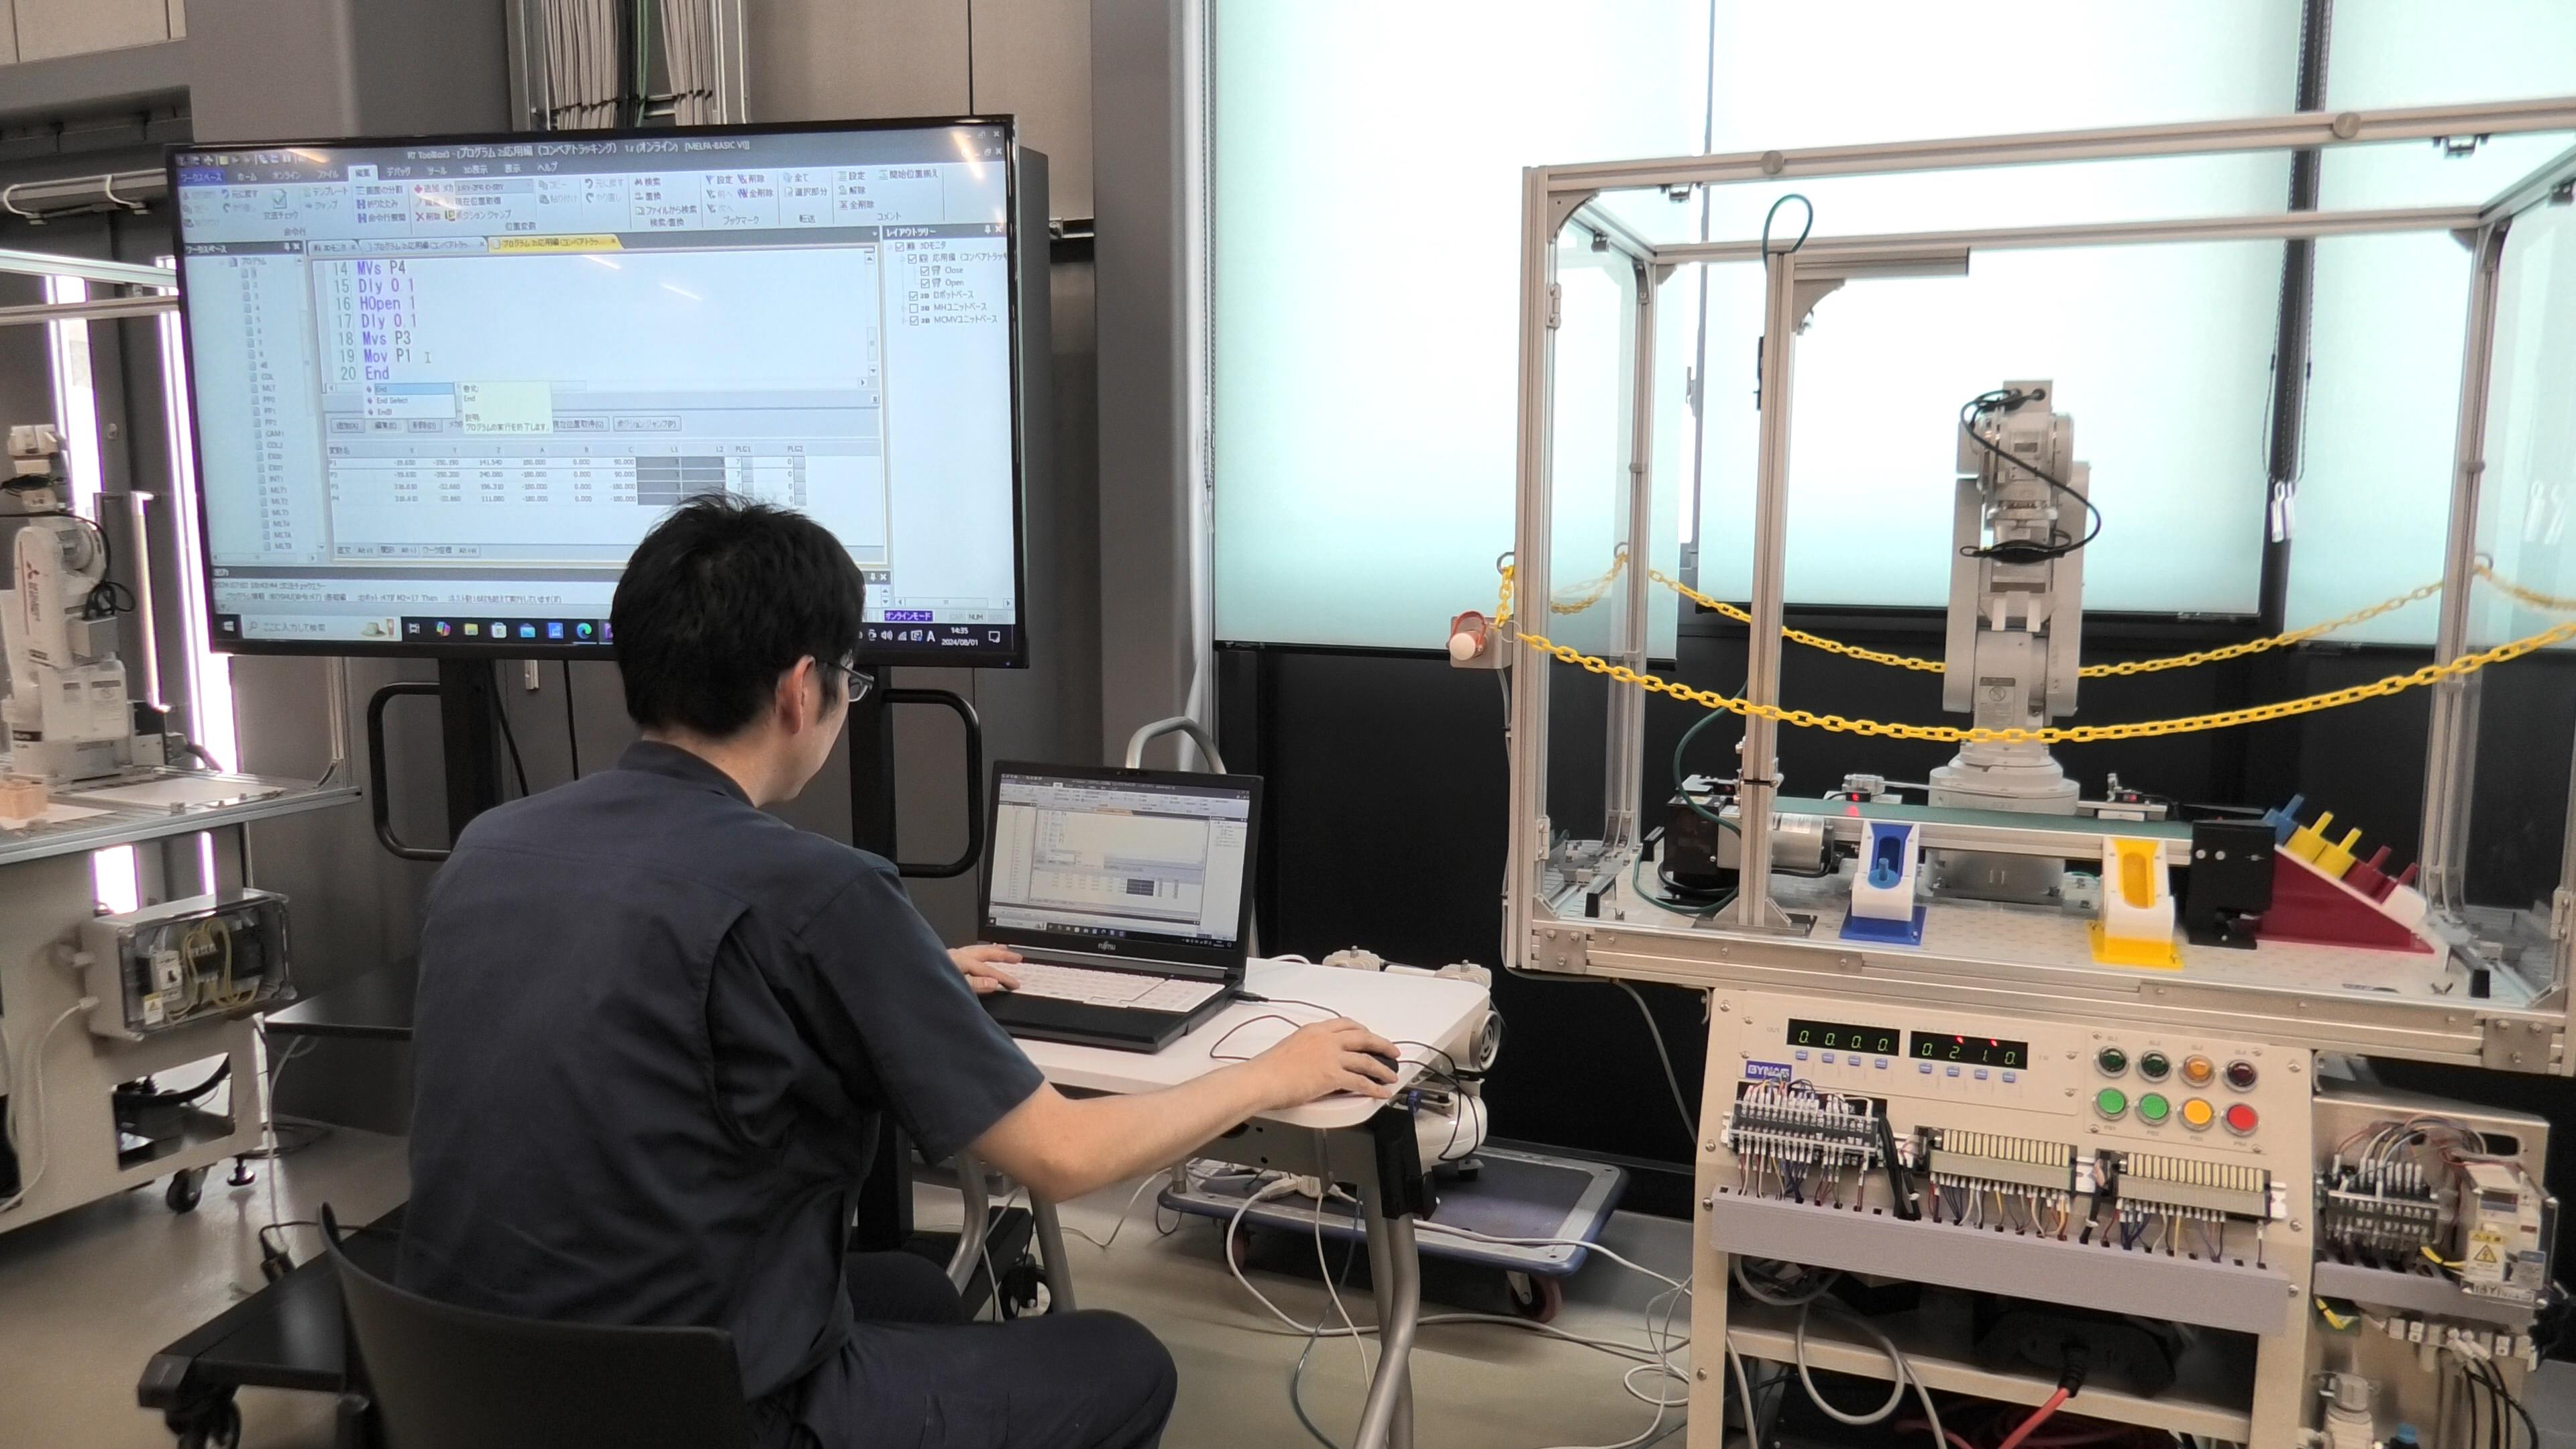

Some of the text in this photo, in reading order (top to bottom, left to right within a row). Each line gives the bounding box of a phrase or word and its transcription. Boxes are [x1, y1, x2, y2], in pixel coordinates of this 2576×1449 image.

[428, 166, 447, 175] ツール
[504, 164, 521, 173] 表示
[537, 162, 558, 172] ヘルプ
[237, 171, 257, 181] ホーム
[272, 170, 301, 180] オンライン
[317, 170, 340, 179] ファイル
[716, 174, 734, 184] 設定
[749, 174, 766, 184] 削除
[794, 173, 809, 182] 全て
[849, 171, 866, 181] 設定
[890, 169, 938, 180] 開始位置揃え
[644, 177, 661, 186] 検索
[749, 189, 774, 199] 全削除
[794, 187, 828, 197] 選択部分
[849, 185, 866, 195] 解除
[645, 192, 662, 201] 置換
[645, 205, 698, 215] ファイルから検索
[849, 200, 875, 210] 全削除
[722, 215, 760, 226] ブックマーク
[799, 214, 816, 224] 転送
[876, 211, 902, 222] コメント
[649, 217, 685, 227] 検索/置換
[886, 227, 936, 237] レイアウトツリー
[920, 241, 946, 250] 3Dモニタ
[333, 260, 407, 276] 14 MVs P4
[945, 266, 963, 274] Close
[335, 278, 350, 293] 15
[358, 278, 383, 294] Dly
[945, 279, 964, 289] Open
[933, 291, 974, 300] ロボットベース
[337, 295, 415, 312] 16 HOpen 1
[933, 303, 987, 312] MHユニットベース
[338, 314, 352, 329] 17
[361, 313, 385, 329] Dly
[339, 330, 411, 346] 18 Mvs P3
[340, 348, 411, 364] 19 Mov P1
[341, 366, 390, 380] 20 End
[376, 385, 388, 393] End
[376, 396, 408, 405] End Select
[464, 394, 476, 402] End
[885, 611, 931, 621] オンラインモード
[263, 622, 327, 633] ここに入力して検索
[951, 627, 969, 635] 14:35
[926, 631, 935, 643] A
[1097, 941, 1116, 951] FUJITSU
